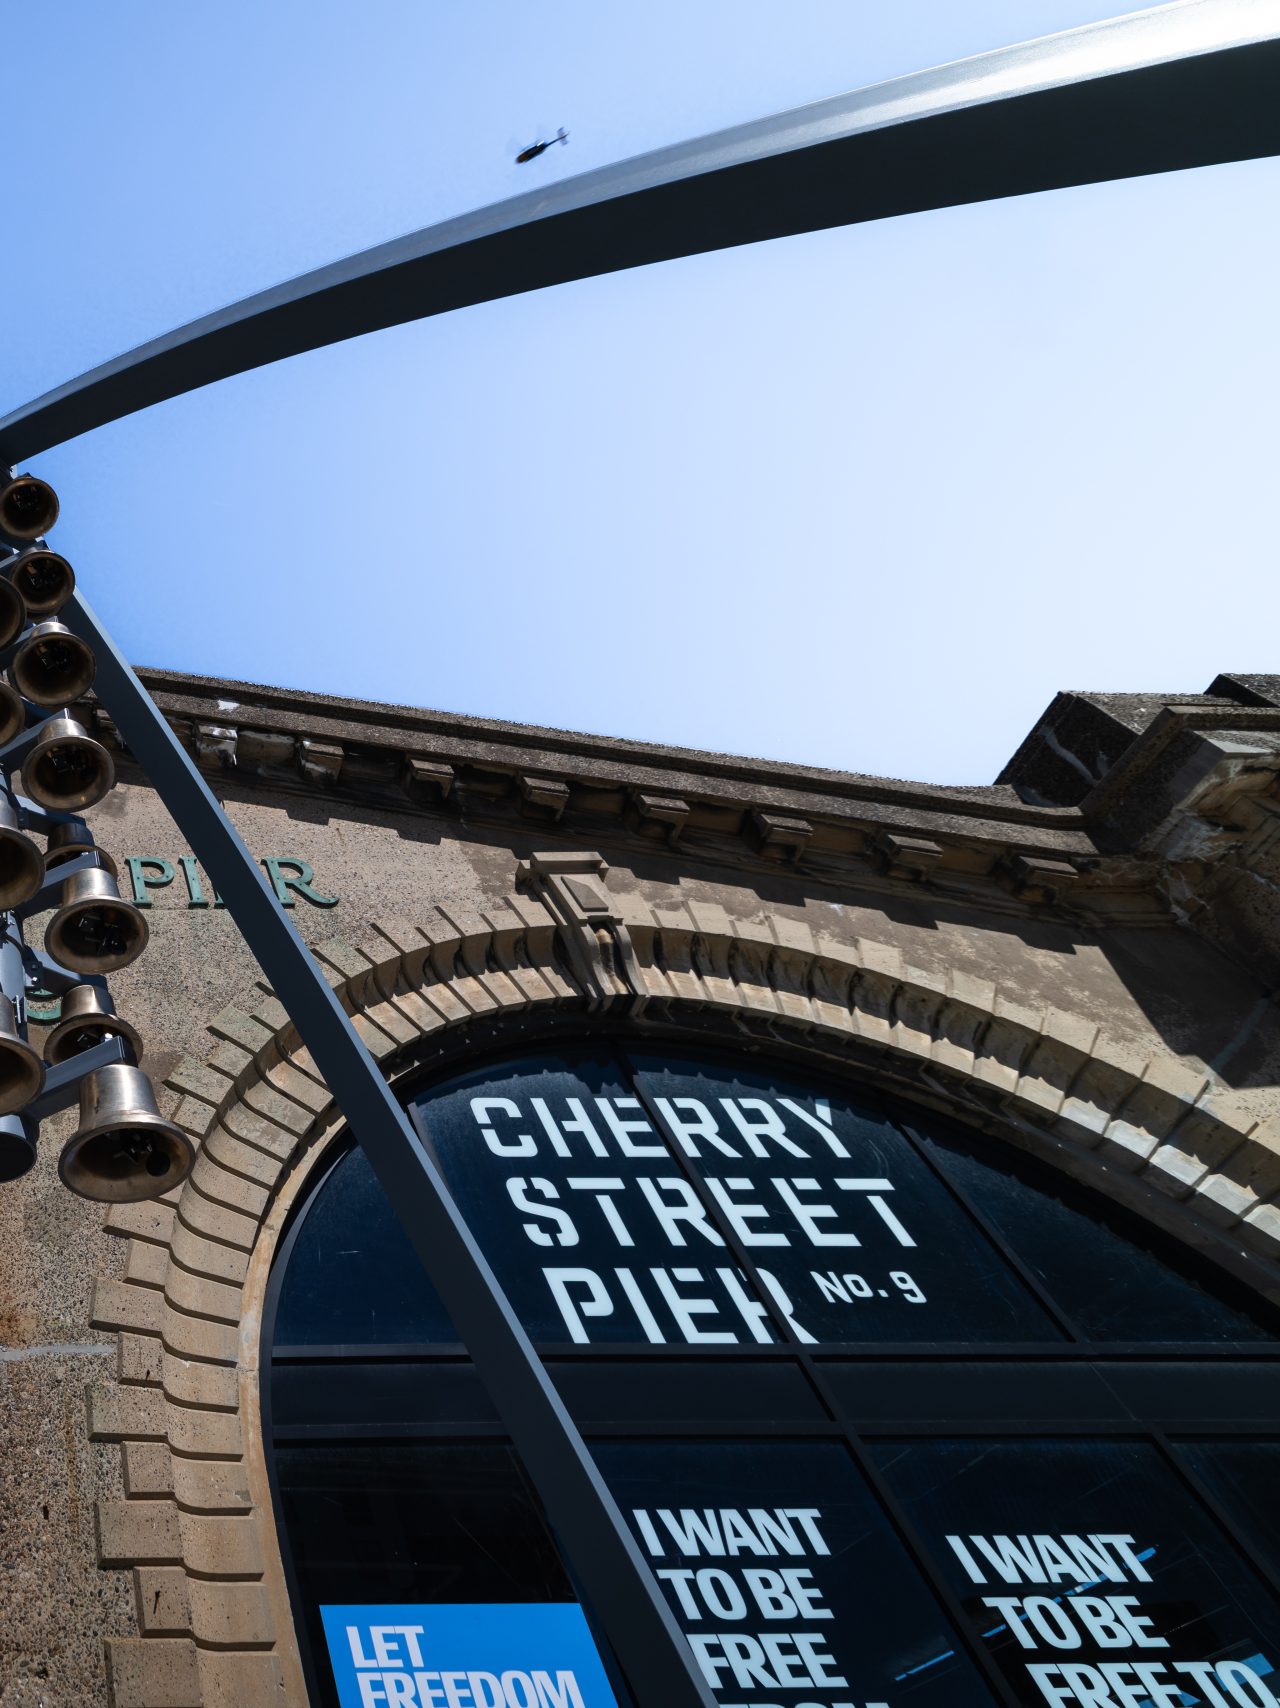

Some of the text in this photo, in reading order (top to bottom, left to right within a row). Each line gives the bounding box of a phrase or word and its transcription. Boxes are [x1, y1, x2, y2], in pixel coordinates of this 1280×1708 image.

[124, 854, 339, 909] PIR
[470, 1097, 851, 1158] CHERRY
[506, 1177, 917, 1247] STREET
[542, 1267, 927, 1344] PIER No. 9
[632, 1508, 831, 1556] I WANT
[945, 1534, 1154, 1584] I WANT
[656, 1568, 835, 1620] TO BE
[346, 1625, 425, 1669] LET
[982, 1595, 1171, 1649] TO BE
[685, 1633, 850, 1688] FREE
[1025, 1661, 1194, 1708] FREE
[355, 1670, 585, 1708] FREEDOM
